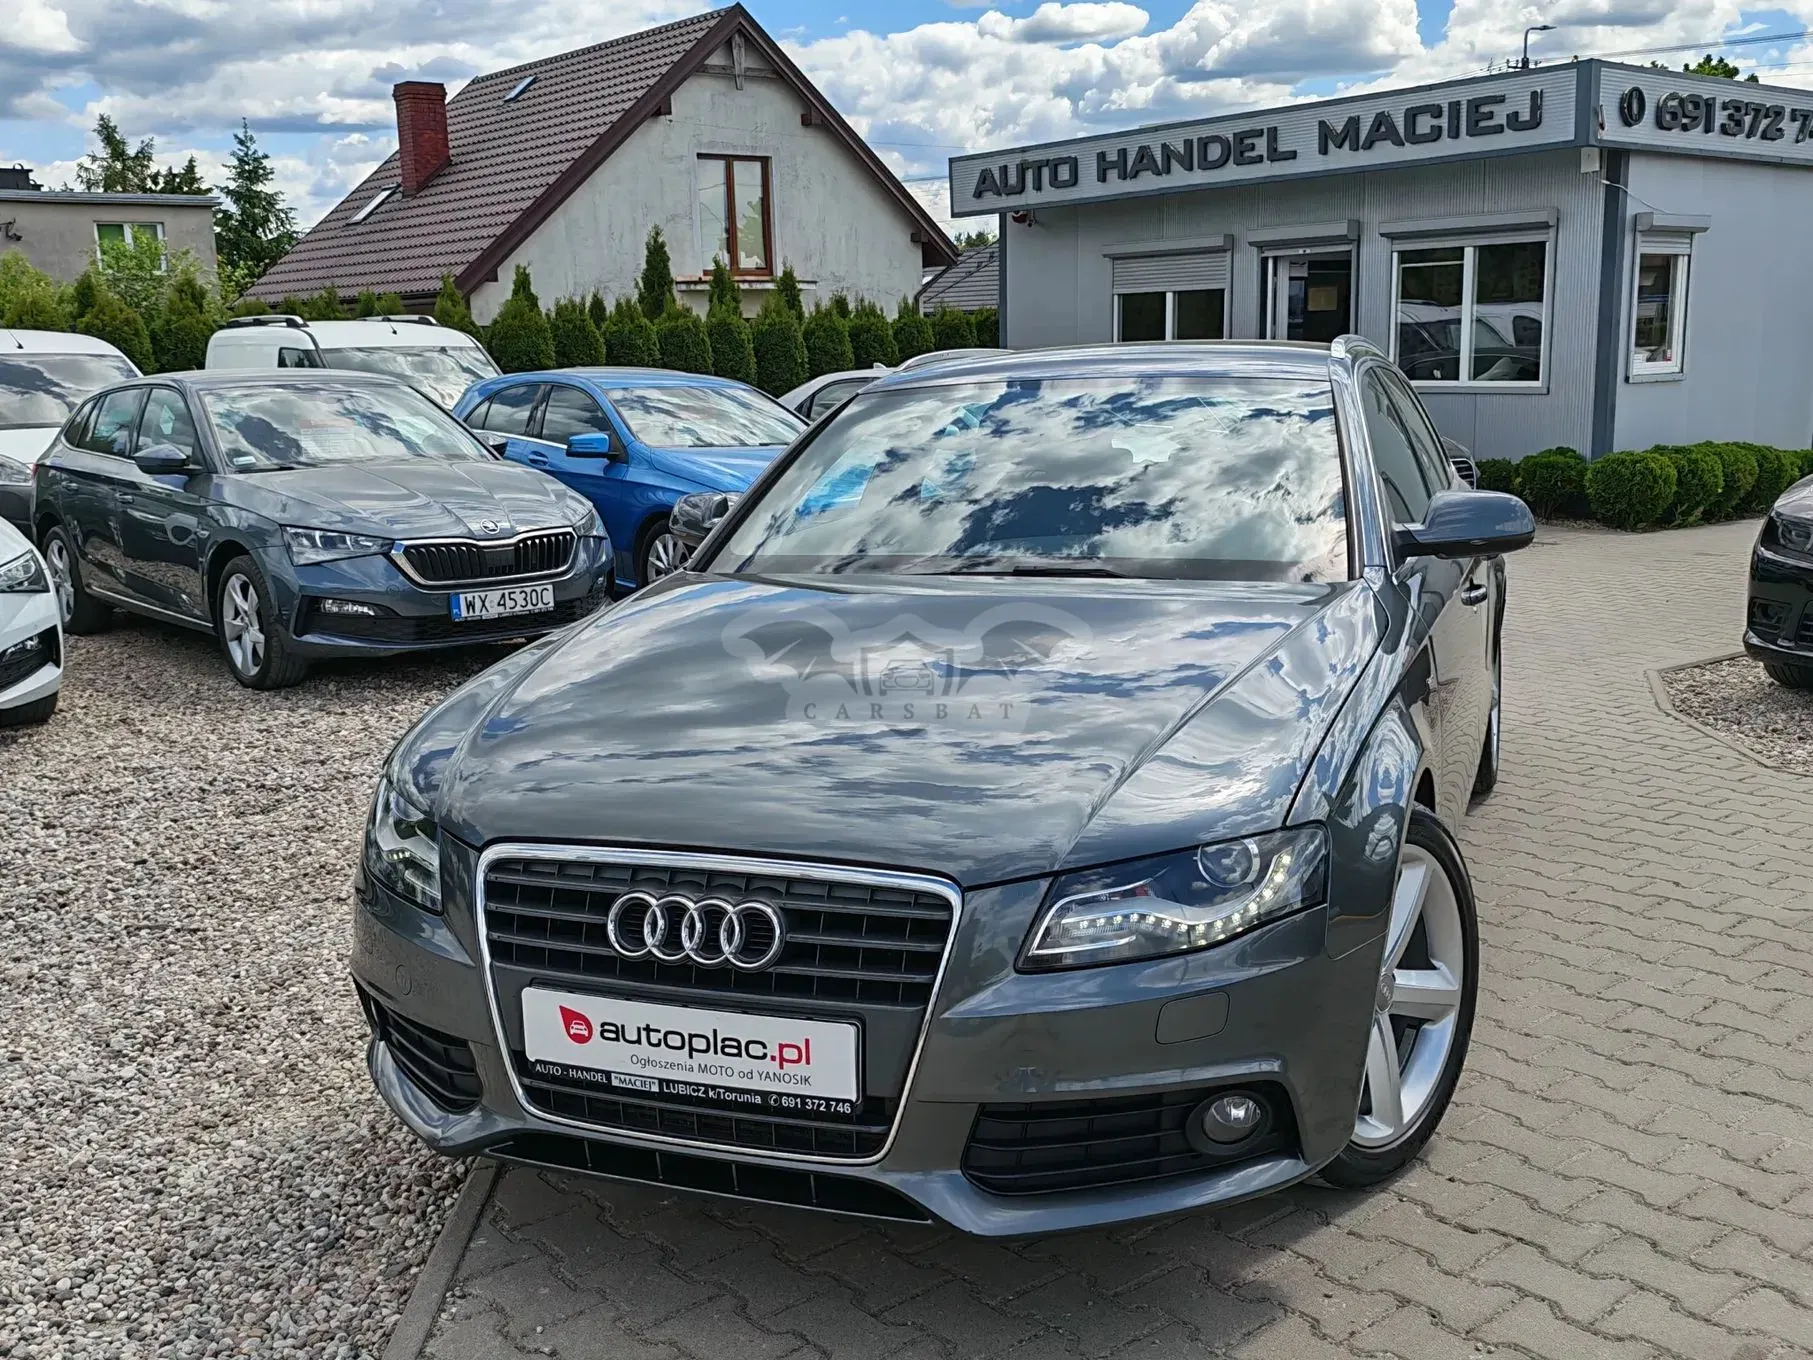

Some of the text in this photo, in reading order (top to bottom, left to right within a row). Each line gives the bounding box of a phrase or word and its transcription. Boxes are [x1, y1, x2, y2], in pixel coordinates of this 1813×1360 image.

[972, 88, 1544, 199] AUTO HANDEL MACIEJ
[1790, 108, 1813, 144] 7
[464, 594, 489, 614] WX
[497, 588, 550, 610] 4530C
[600, 1020, 812, 1070] autoplac.pl
[535, 1063, 562, 1077] AUTO
[569, 1068, 608, 1084] HANDEL
[663, 1081, 706, 1097] LUBICZ
[708, 1087, 762, 1104] k/Torunia
[781, 1095, 801, 1108] 691
[805, 1099, 826, 1112] 372
[829, 1100, 851, 1114] 746
[630, 1054, 812, 1087] Ogłoszenia MOTO od YANOSIK
